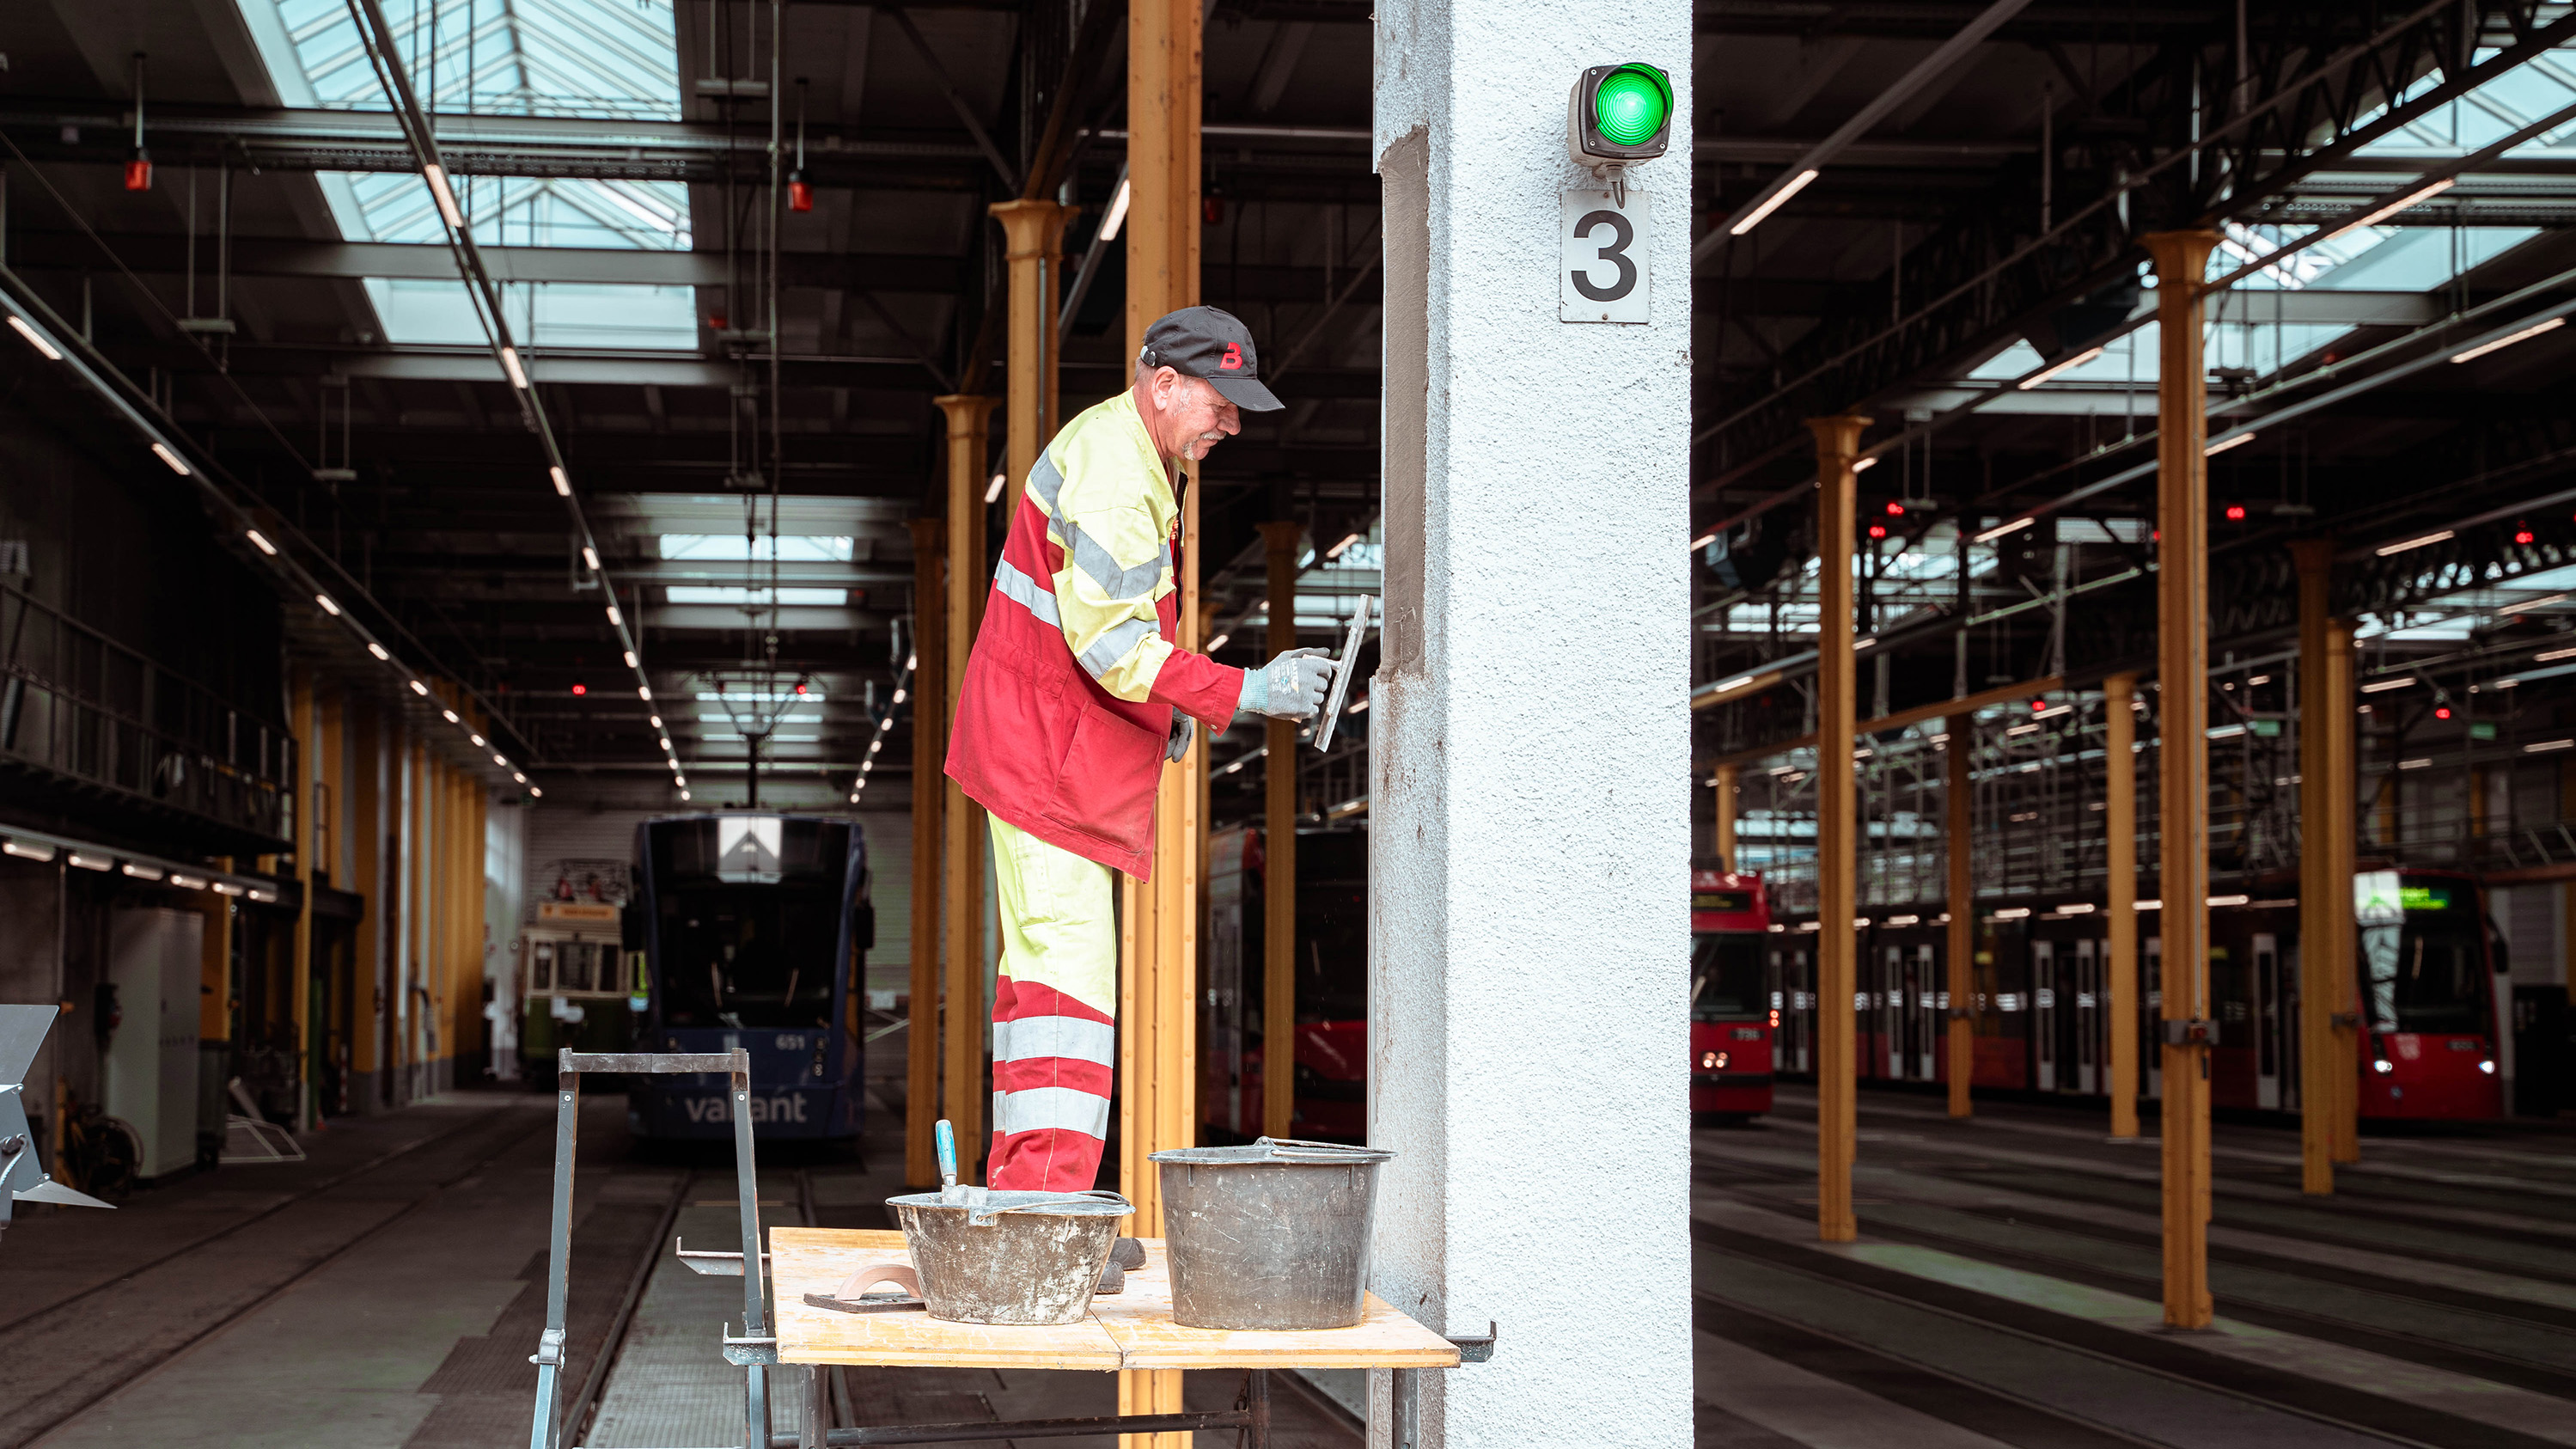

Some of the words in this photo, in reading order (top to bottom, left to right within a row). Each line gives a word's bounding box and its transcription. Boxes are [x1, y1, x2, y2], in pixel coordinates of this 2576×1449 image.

[1571, 210, 1637, 302] 3
[1219, 342, 1243, 370] B
[775, 1033, 805, 1051] 651
